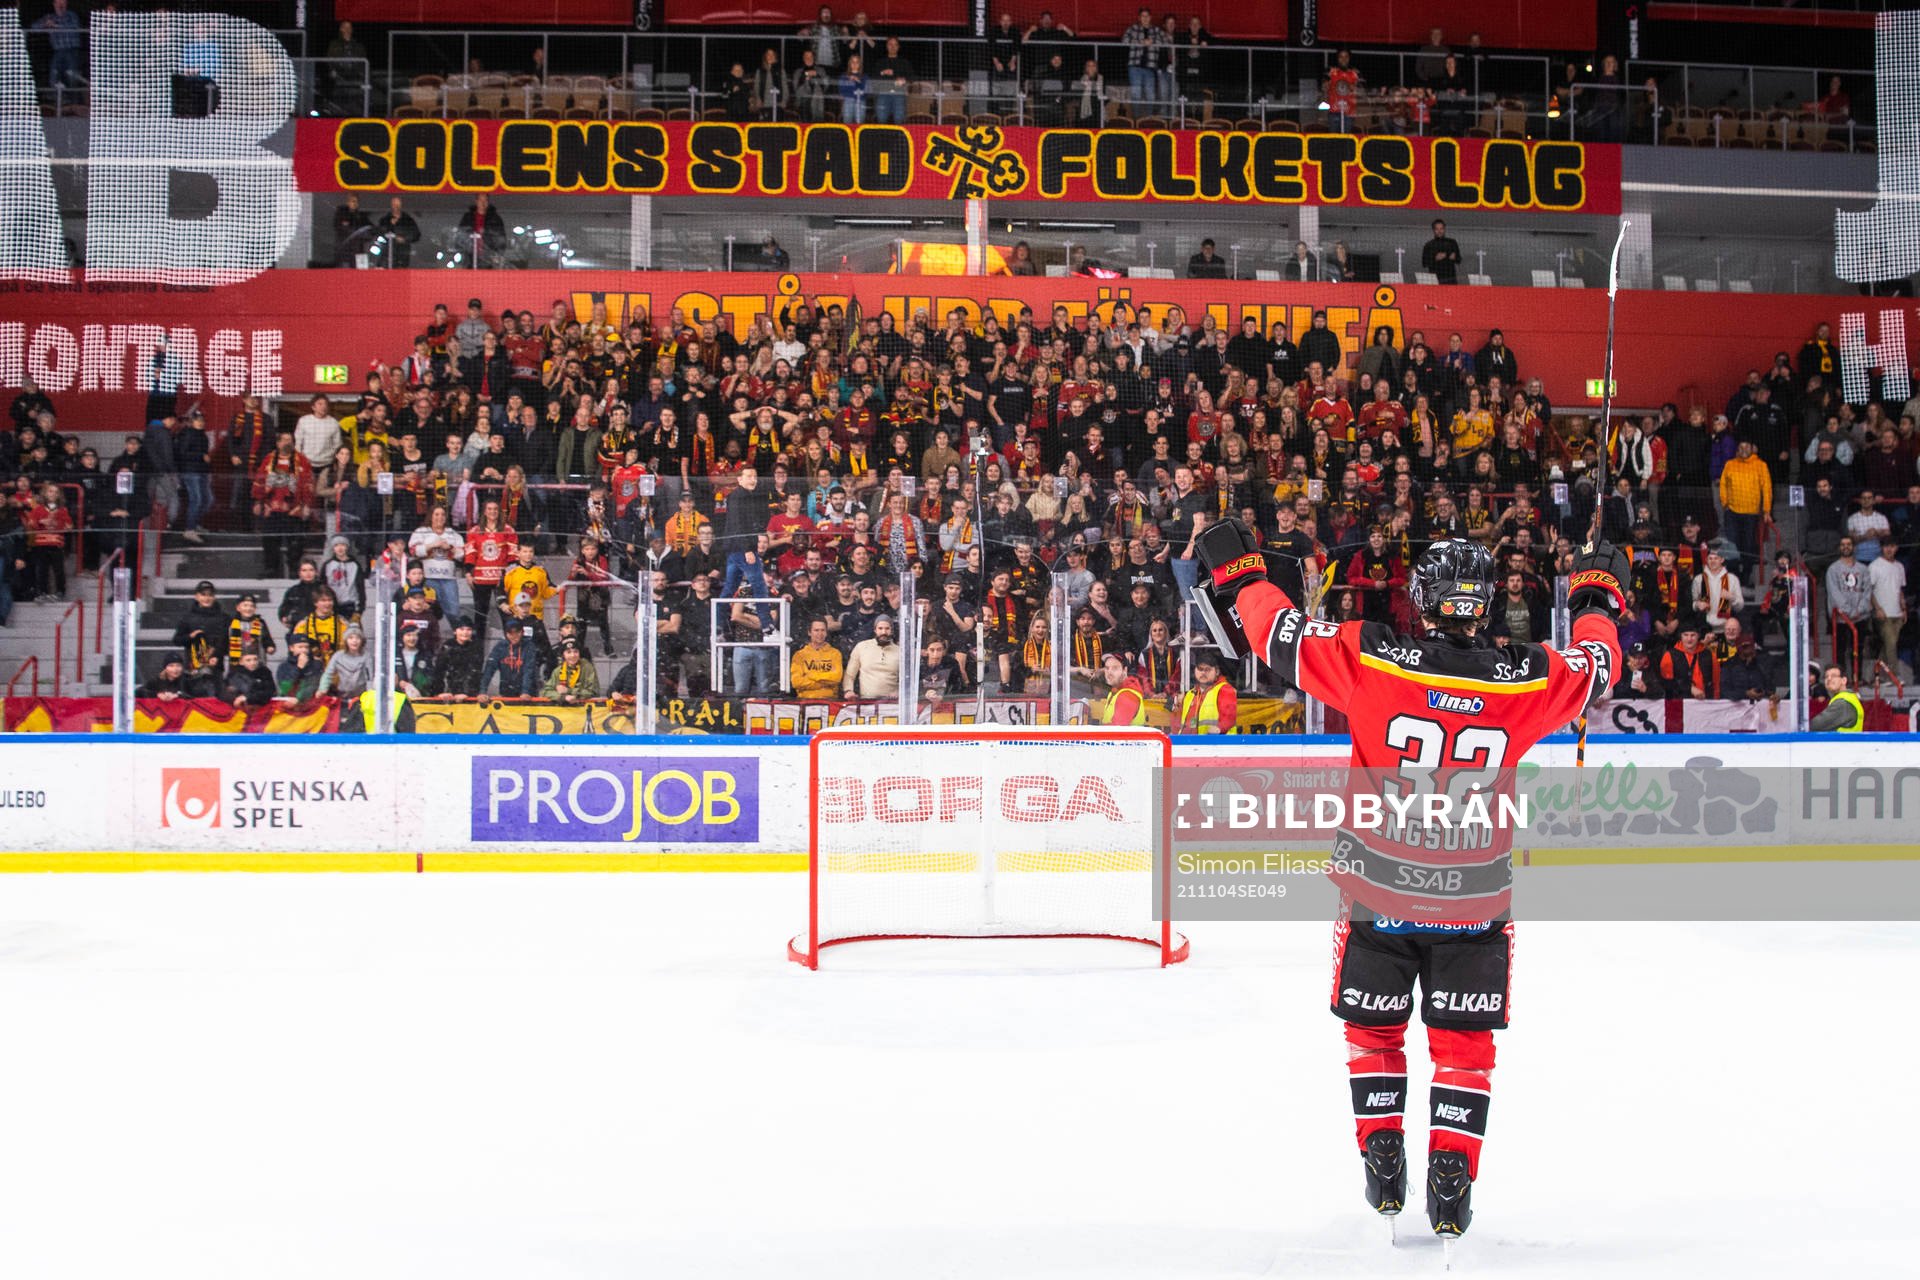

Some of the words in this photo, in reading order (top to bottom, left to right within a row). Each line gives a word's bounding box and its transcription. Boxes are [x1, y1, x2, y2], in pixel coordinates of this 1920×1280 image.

[335, 118, 668, 192] SOLENS
[688, 121, 914, 195] STAD
[1037, 128, 1415, 206] FOLKETS
[1431, 138, 1585, 211] LAG
[673, 273, 851, 345] STÅ
[1840, 309, 1920, 405] H
[1456, 601, 1474, 616] 32
[1301, 618, 1340, 638] 2
[1377, 641, 1422, 666] SSAB
[1427, 689, 1485, 715] Vinab
[1385, 712, 1511, 822] 32
[1283, 769, 1326, 788] Smart
[1329, 769, 1341, 788] &
[233, 780, 369, 802] SVENSKA
[488, 769, 741, 842] PROJOB
[233, 808, 303, 829] SPEL
[1395, 865, 1463, 892] SSAB
[1361, 991, 1410, 1012] LKAB
[1449, 992, 1503, 1013] LKAB
[1365, 1091, 1400, 1108] NEX
[1435, 1102, 1473, 1124] NEX
